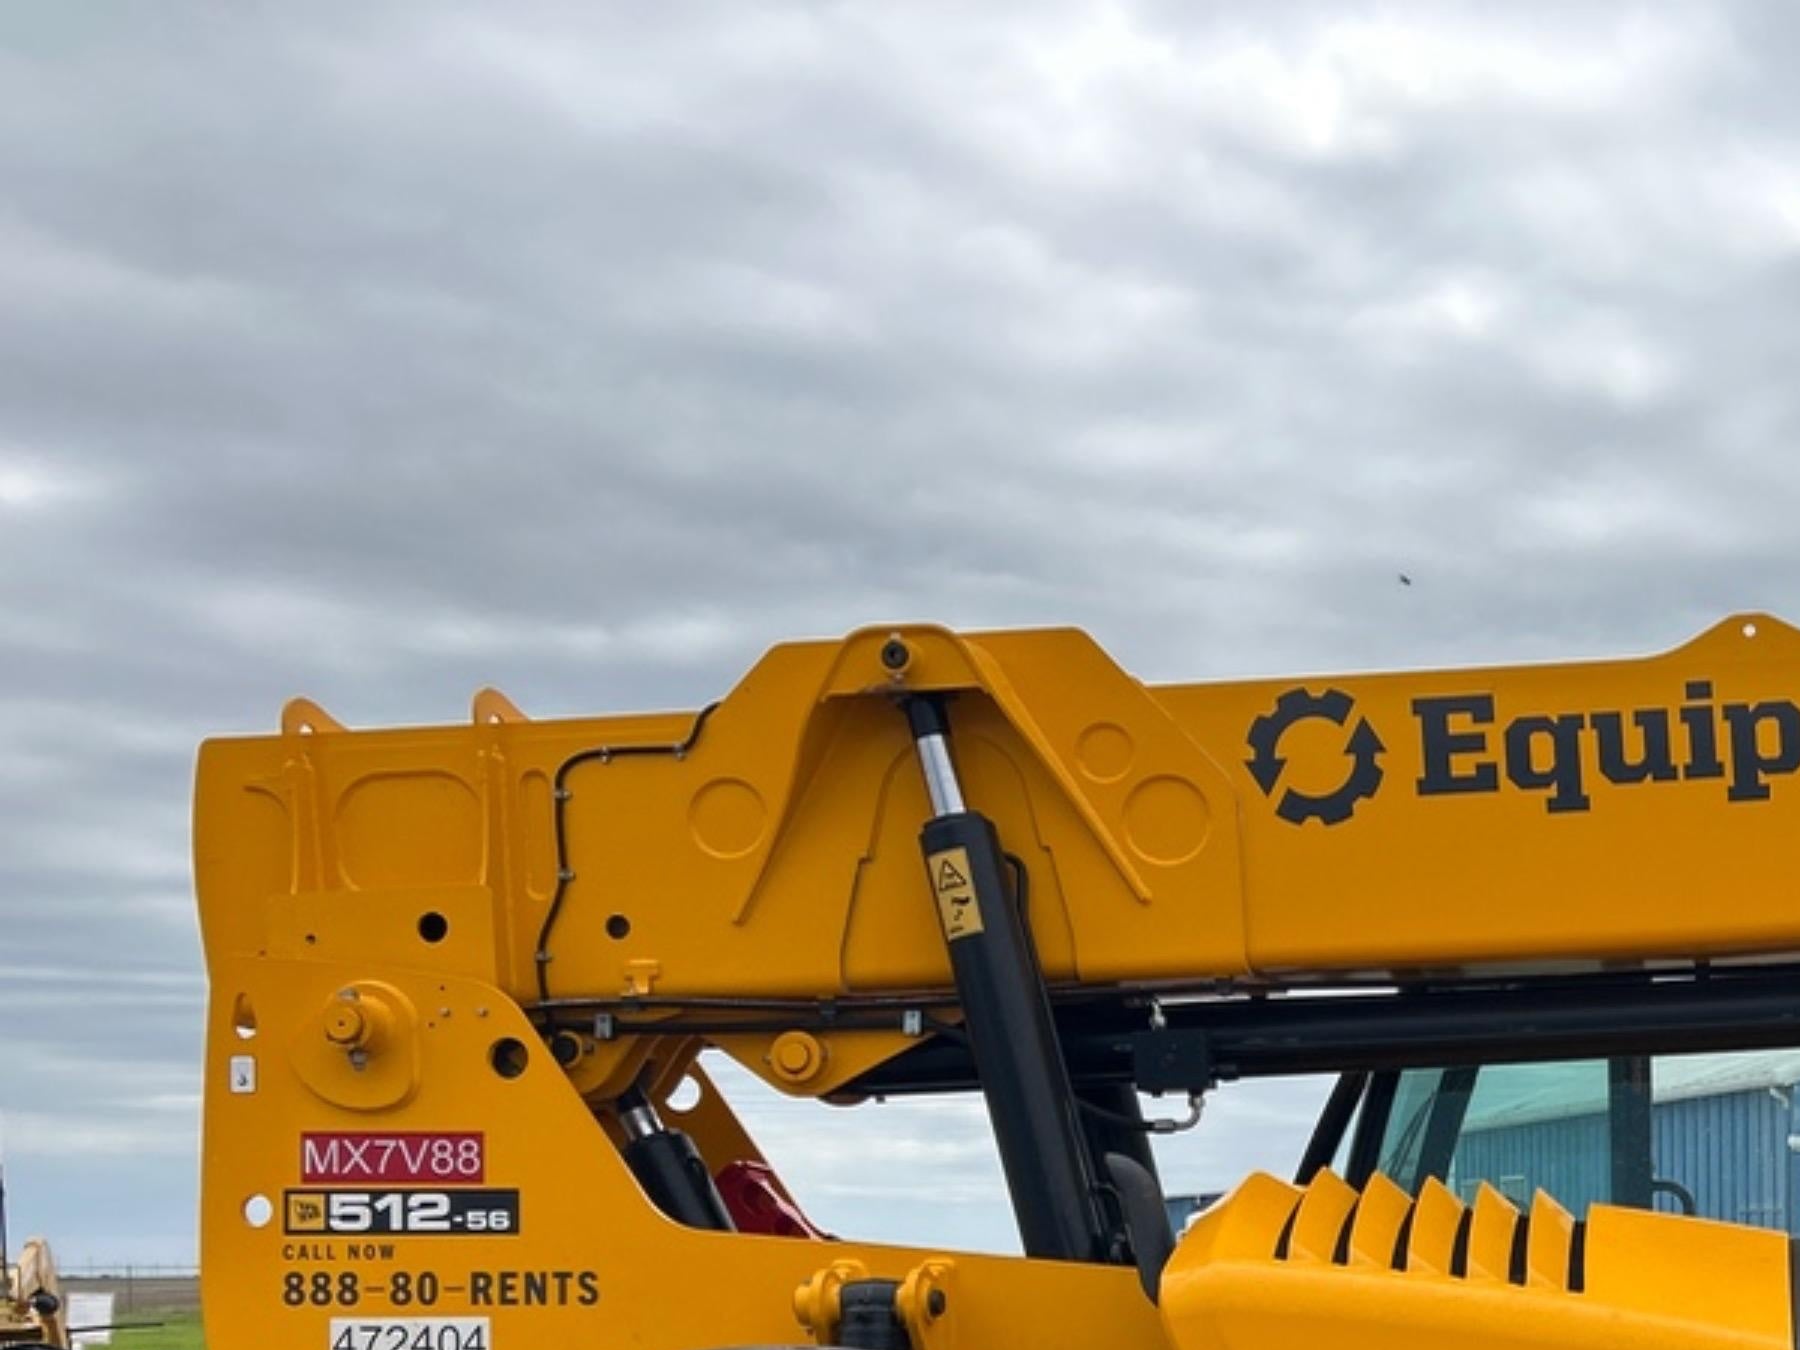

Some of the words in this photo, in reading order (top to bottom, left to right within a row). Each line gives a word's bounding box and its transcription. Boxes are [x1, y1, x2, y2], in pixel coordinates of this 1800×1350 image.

[304, 1139, 480, 1175] MX7V88
[283, 1244, 336, 1260] CALL
[348, 1244, 394, 1260] NOW
[283, 1271, 599, 1306] 888-80-RENTS
